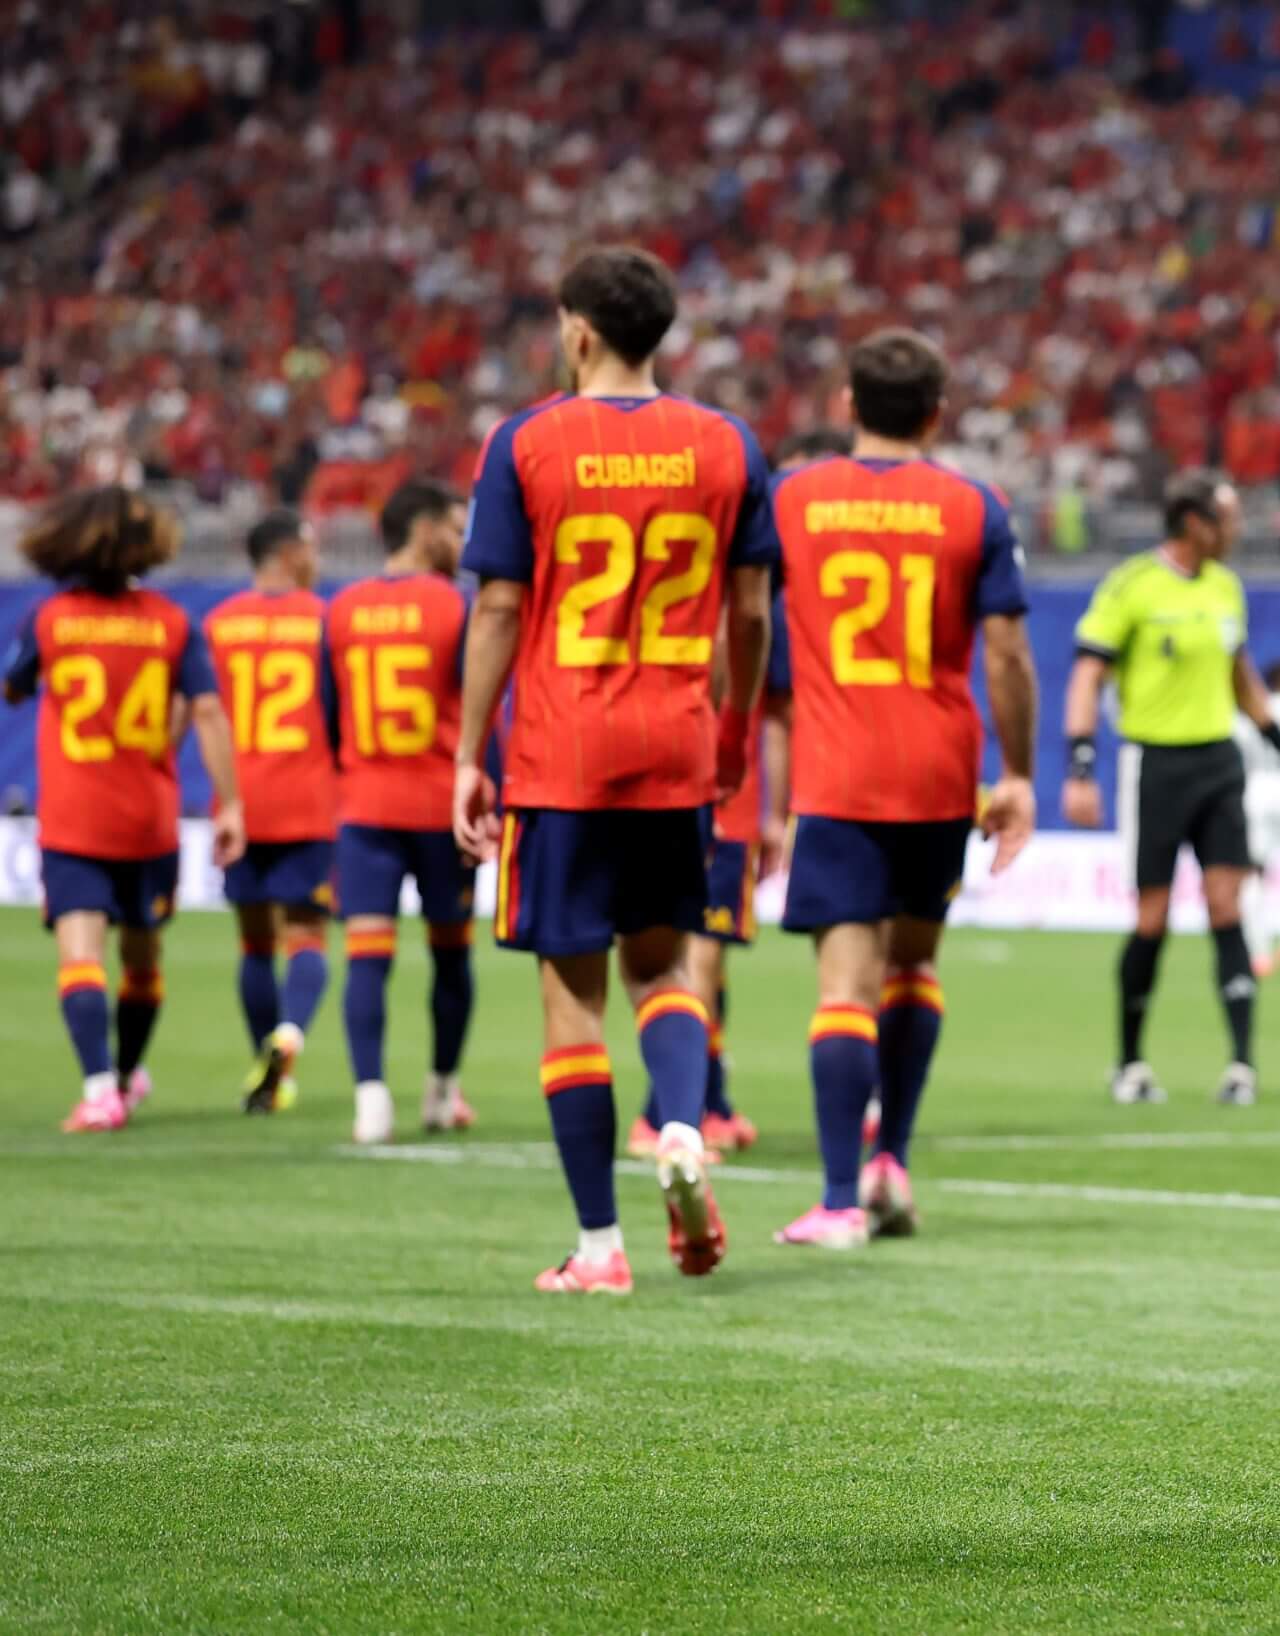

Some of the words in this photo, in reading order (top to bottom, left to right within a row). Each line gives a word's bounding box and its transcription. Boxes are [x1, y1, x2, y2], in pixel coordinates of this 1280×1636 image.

[576, 447, 695, 489] CUBARSÍ
[555, 513, 717, 668] 22
[819, 550, 936, 689] 21
[50, 654, 170, 763] 24
[228, 651, 317, 754] 12
[345, 645, 437, 757] 15
